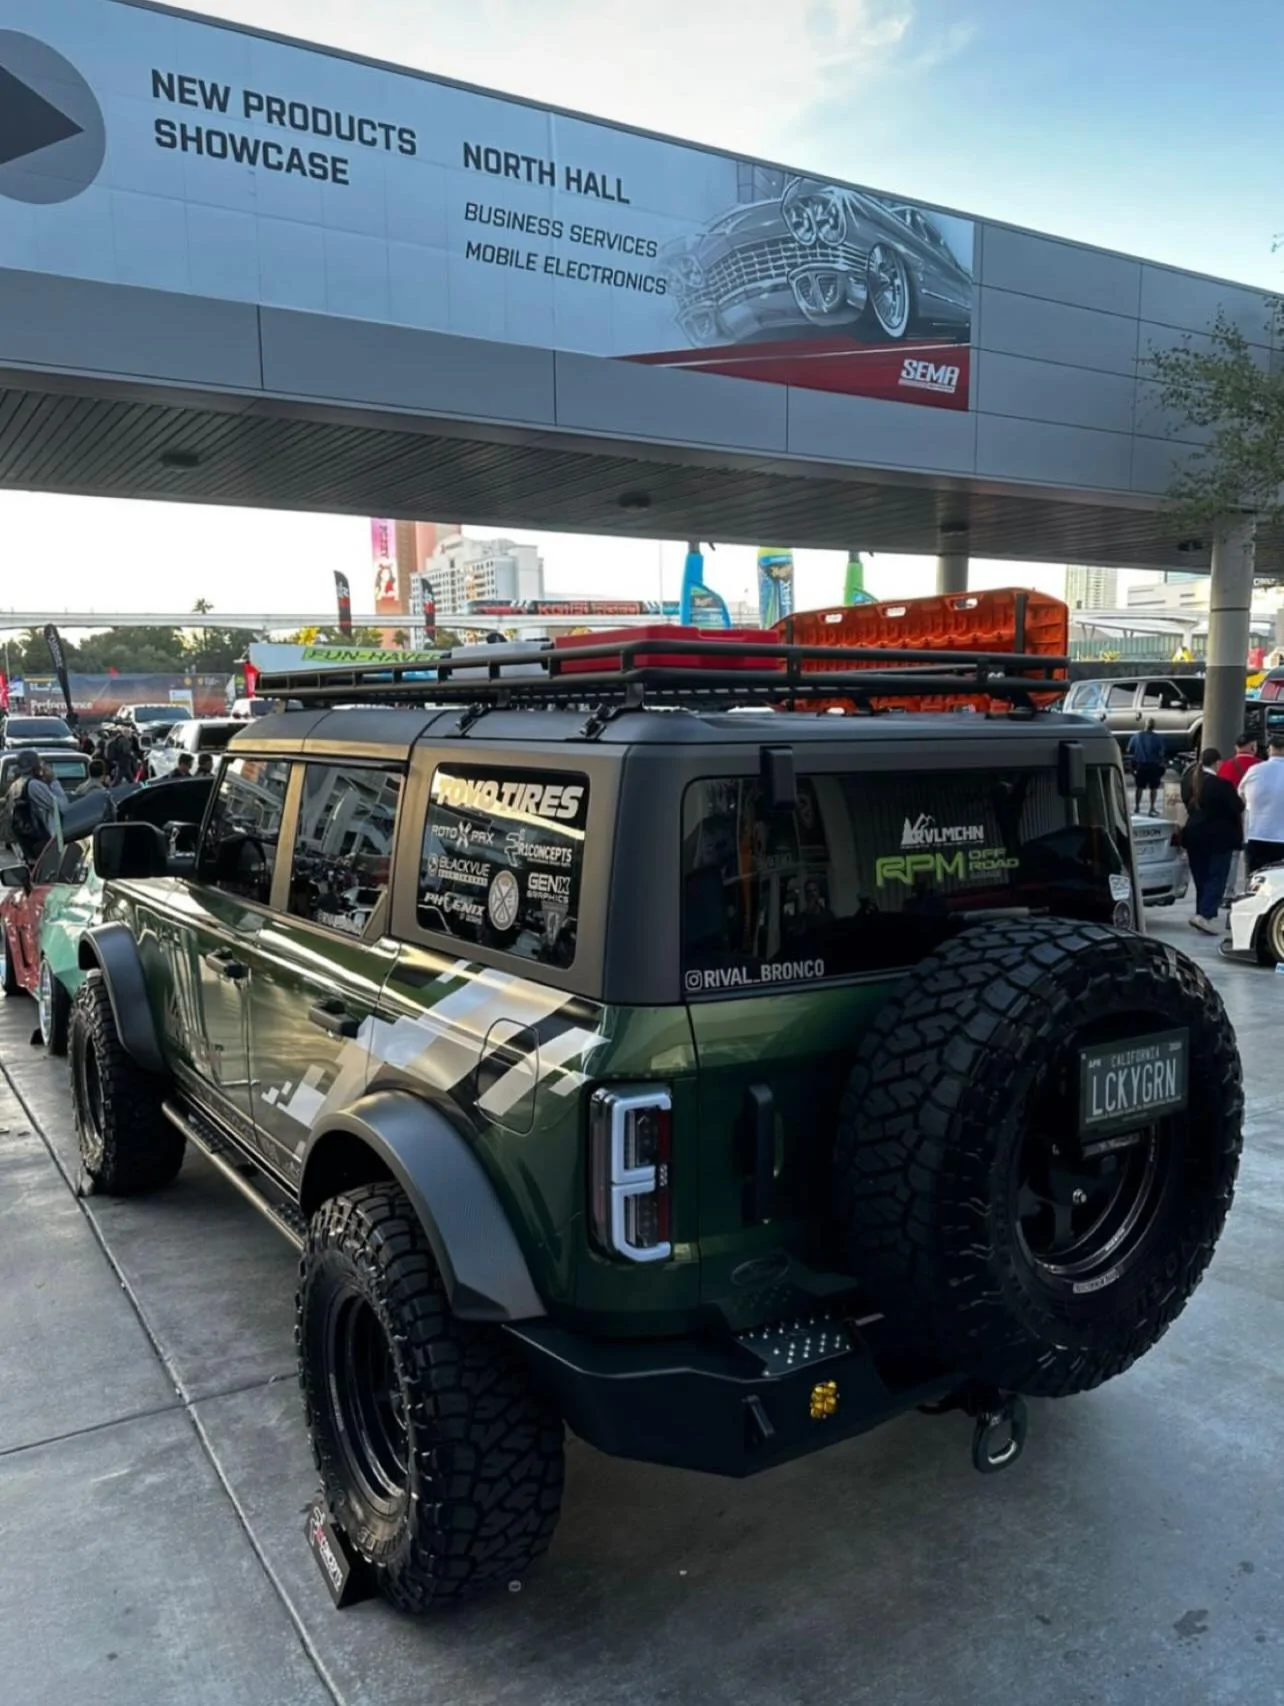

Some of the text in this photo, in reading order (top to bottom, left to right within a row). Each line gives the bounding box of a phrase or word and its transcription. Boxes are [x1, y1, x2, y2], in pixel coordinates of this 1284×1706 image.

[152, 69, 417, 156] NEW PRODUCTS
[154, 118, 349, 185] SHOWCASE
[463, 142, 630, 204] NORTH HALL
[464, 202, 658, 258] BUSINESS SERVICES
[466, 241, 668, 295] MOBILE ELECTRONICS
[901, 358, 960, 386] SEMA
[437, 775, 585, 819] TOYO TIRES
[439, 855, 491, 877] BLACKVUE
[527, 871, 571, 895] GENX
[876, 847, 1007, 888] RPM OFF
[968, 858, 1019, 871] ROAD
[1111, 1045, 1160, 1068] CALIFORNIA
[1092, 1058, 1176, 1116] LCKYGRN
